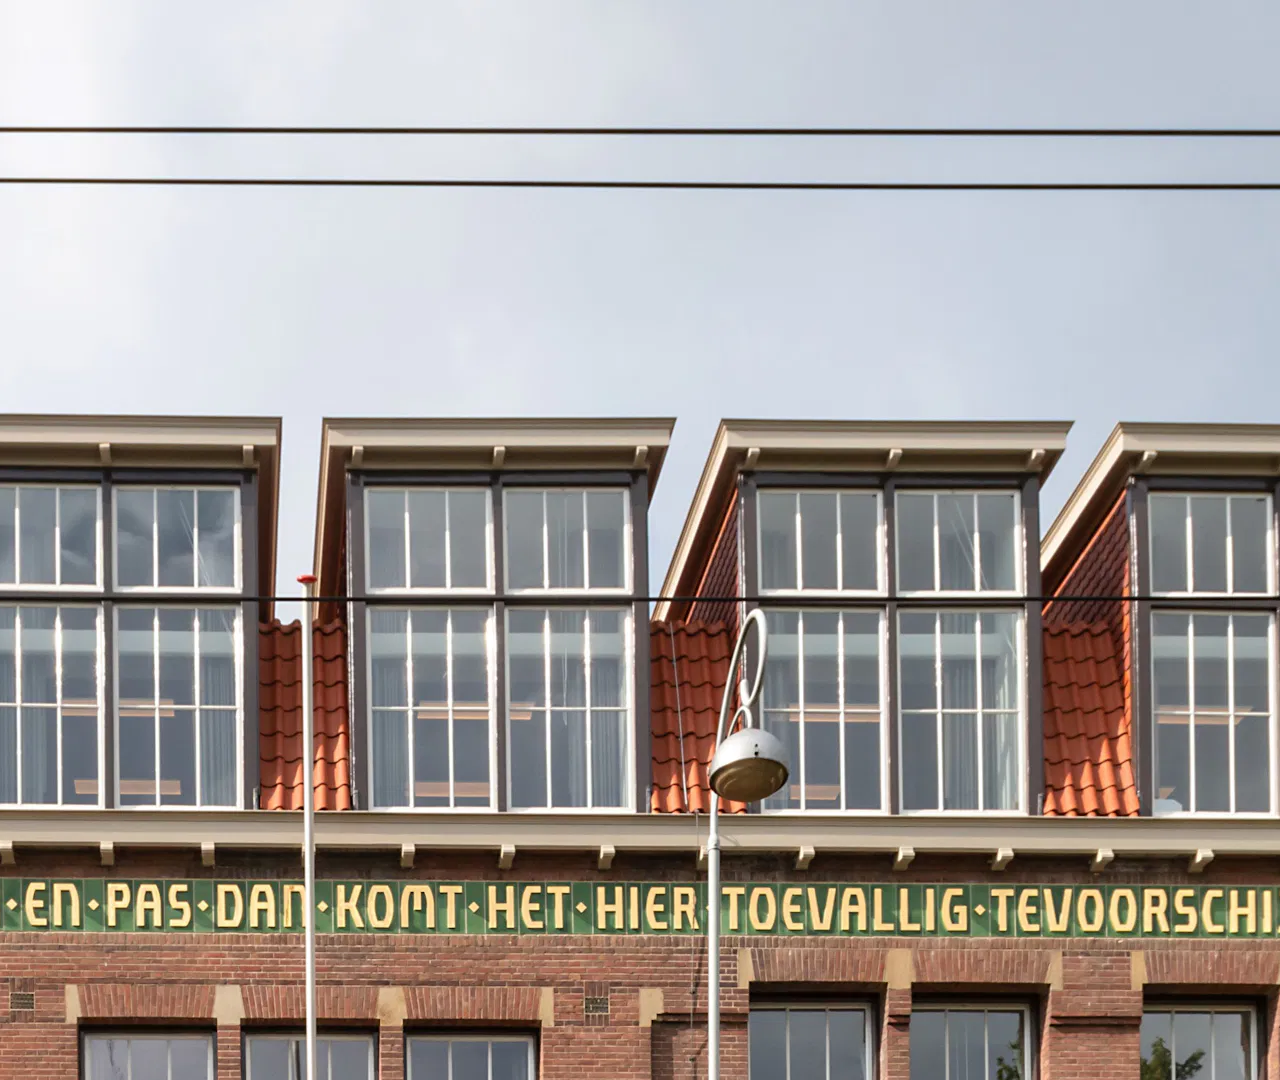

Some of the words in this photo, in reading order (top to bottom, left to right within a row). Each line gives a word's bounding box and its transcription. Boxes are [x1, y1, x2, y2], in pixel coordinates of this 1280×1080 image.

[24, 882, 80, 927] EN
[107, 883, 192, 927] PAS
[216, 884, 307, 928] DAN
[336, 884, 463, 929] KOMT
[488, 885, 570, 929] HET
[597, 886, 700, 930] HIER
[721, 887, 968, 931] TOEVALLIG
